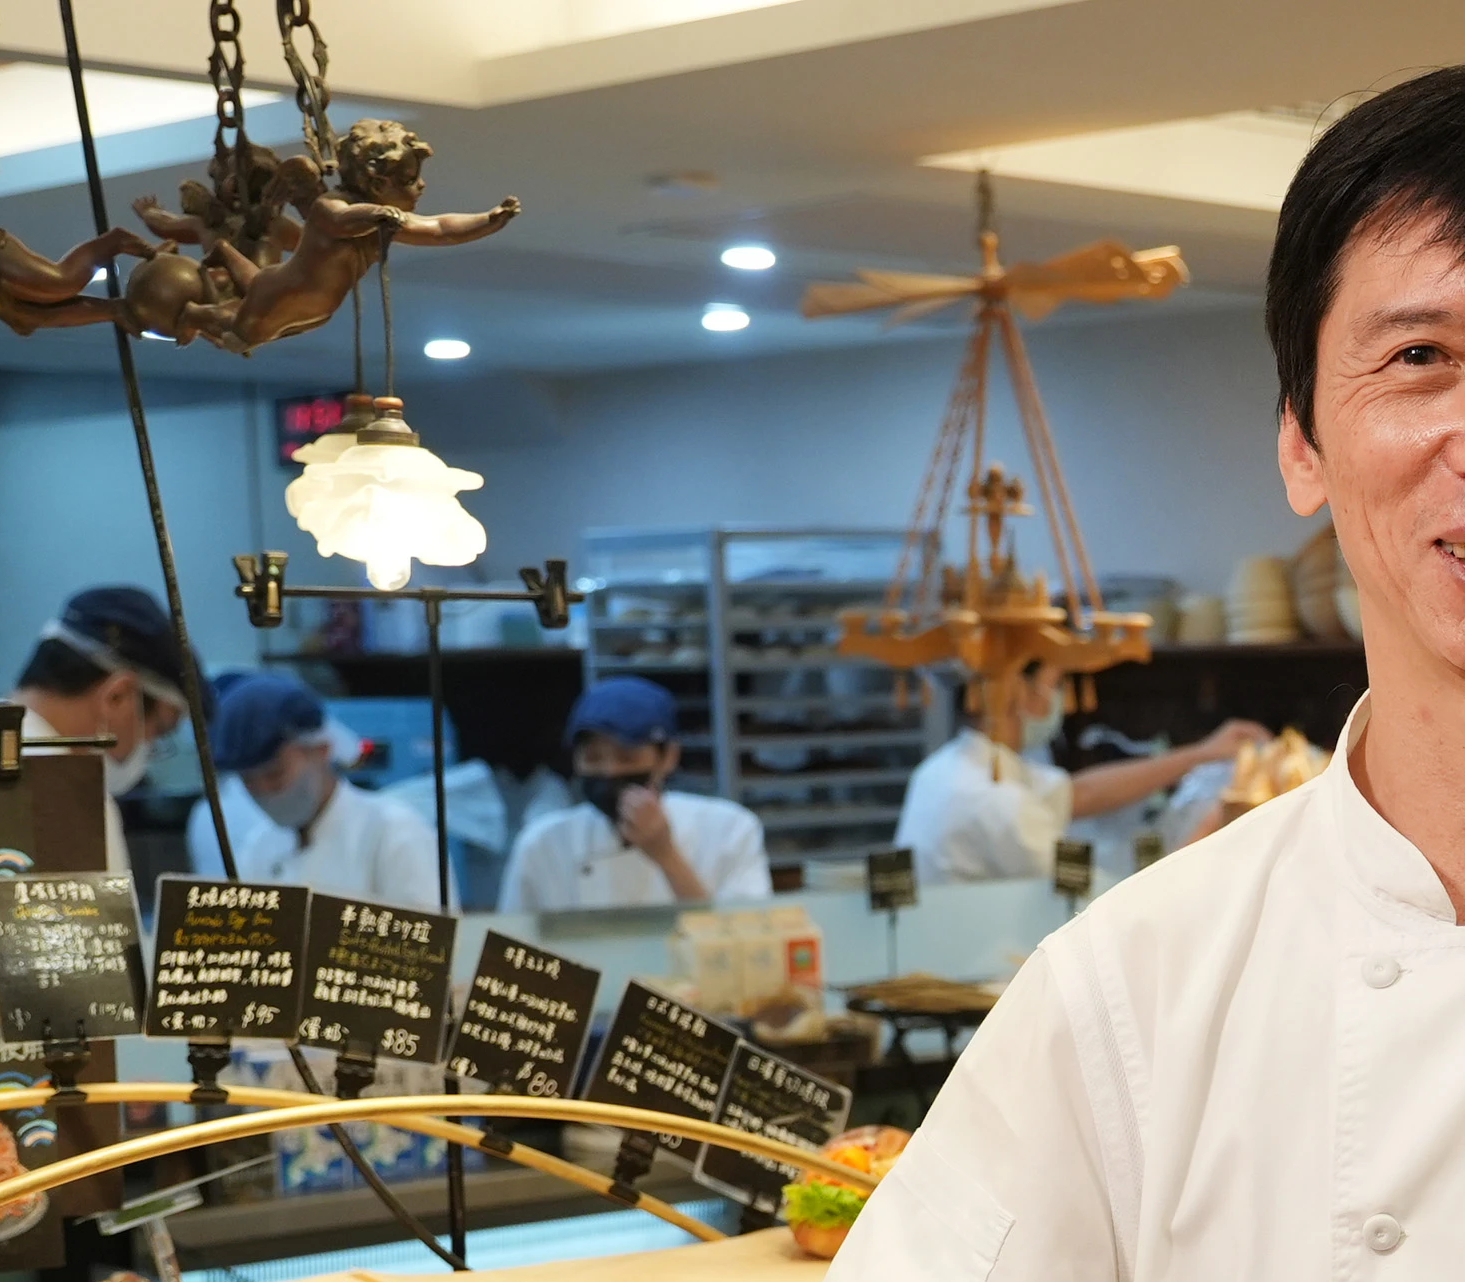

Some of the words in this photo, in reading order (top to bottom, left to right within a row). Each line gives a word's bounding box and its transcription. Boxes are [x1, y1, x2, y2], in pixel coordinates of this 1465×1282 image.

[340, 904, 432, 944] 半熟蛋沙拉
[241, 1001, 281, 1029] $95
[379, 1026, 421, 1057] $85
